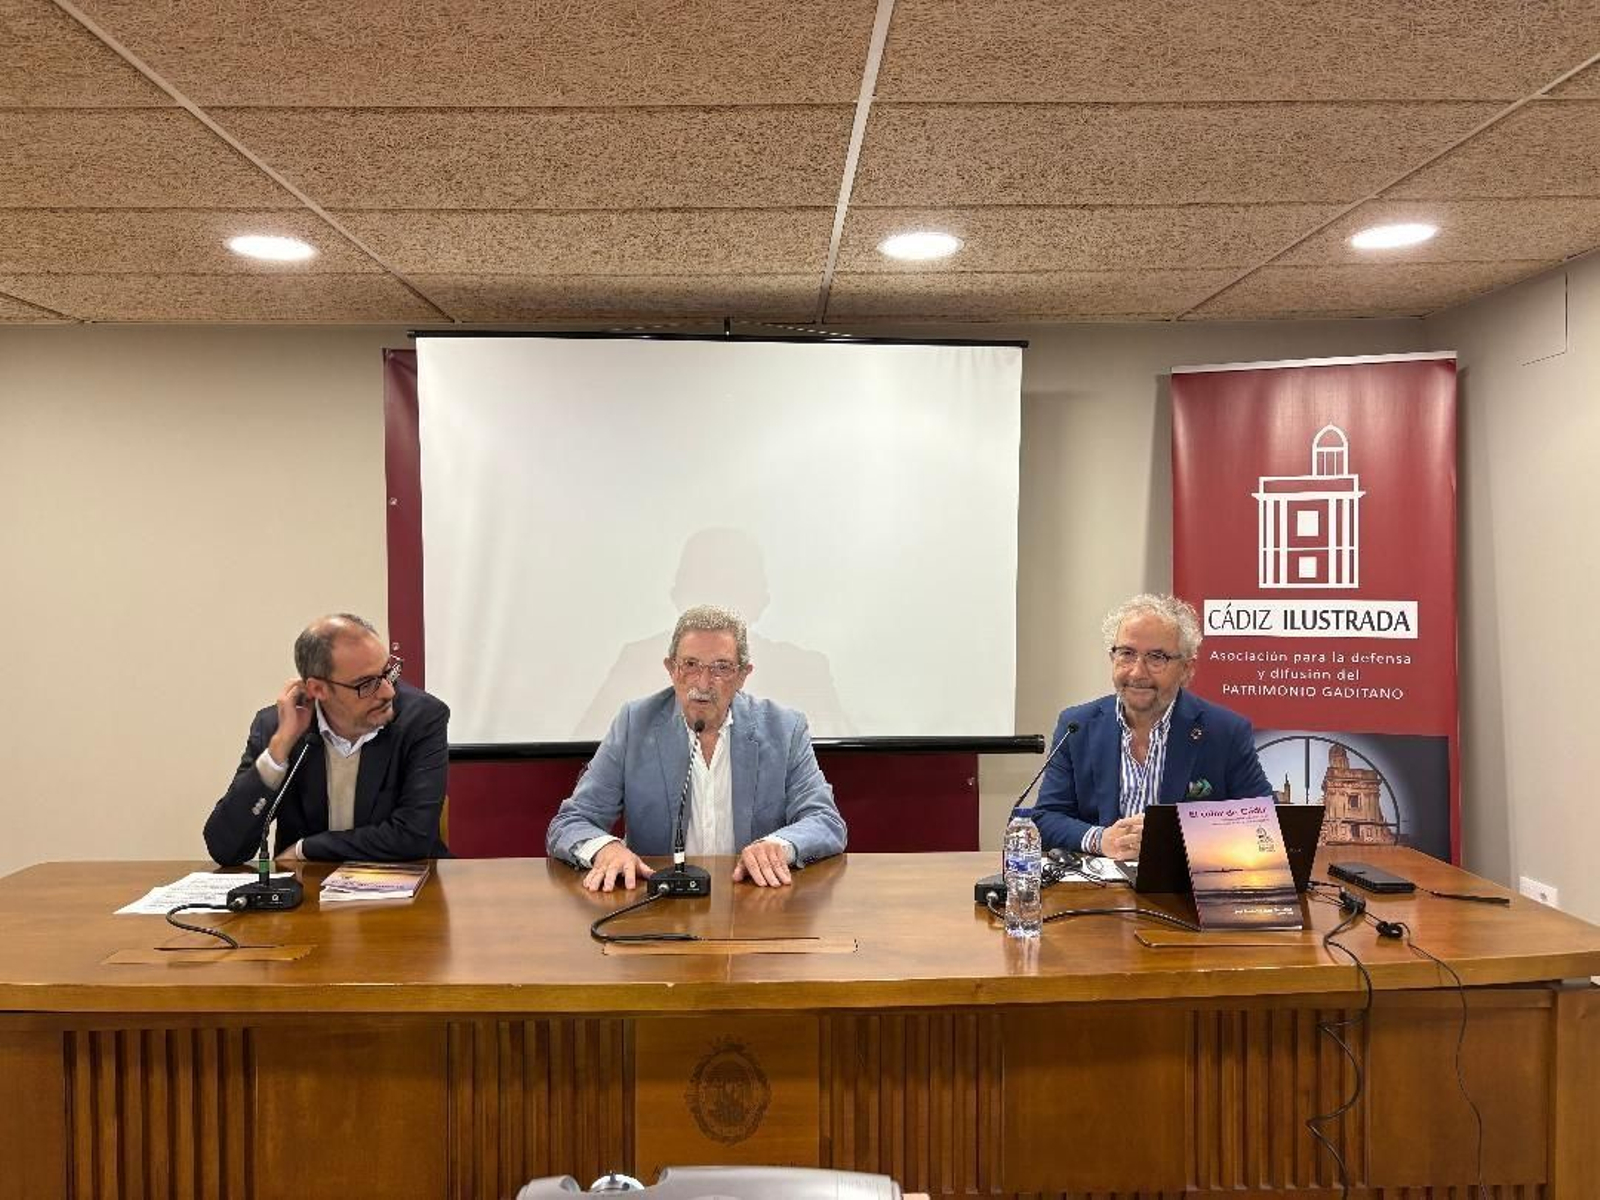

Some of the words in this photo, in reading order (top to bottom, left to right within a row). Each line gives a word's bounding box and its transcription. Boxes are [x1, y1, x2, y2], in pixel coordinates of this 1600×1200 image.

[1208, 602, 1273, 630] CÁDIZ
[1283, 609, 1411, 632] ILUSTRADA
[1209, 650, 1288, 662] Asociación
[1293, 653, 1326, 664] para
[1332, 651, 1345, 663] la
[1351, 652, 1411, 665] defensa
[1257, 669, 1266, 680] y
[1270, 667, 1331, 680] difusión
[1337, 668, 1360, 681] del
[1222, 684, 1317, 698] PATRIMONIO
[1322, 686, 1404, 700] GADITANO
